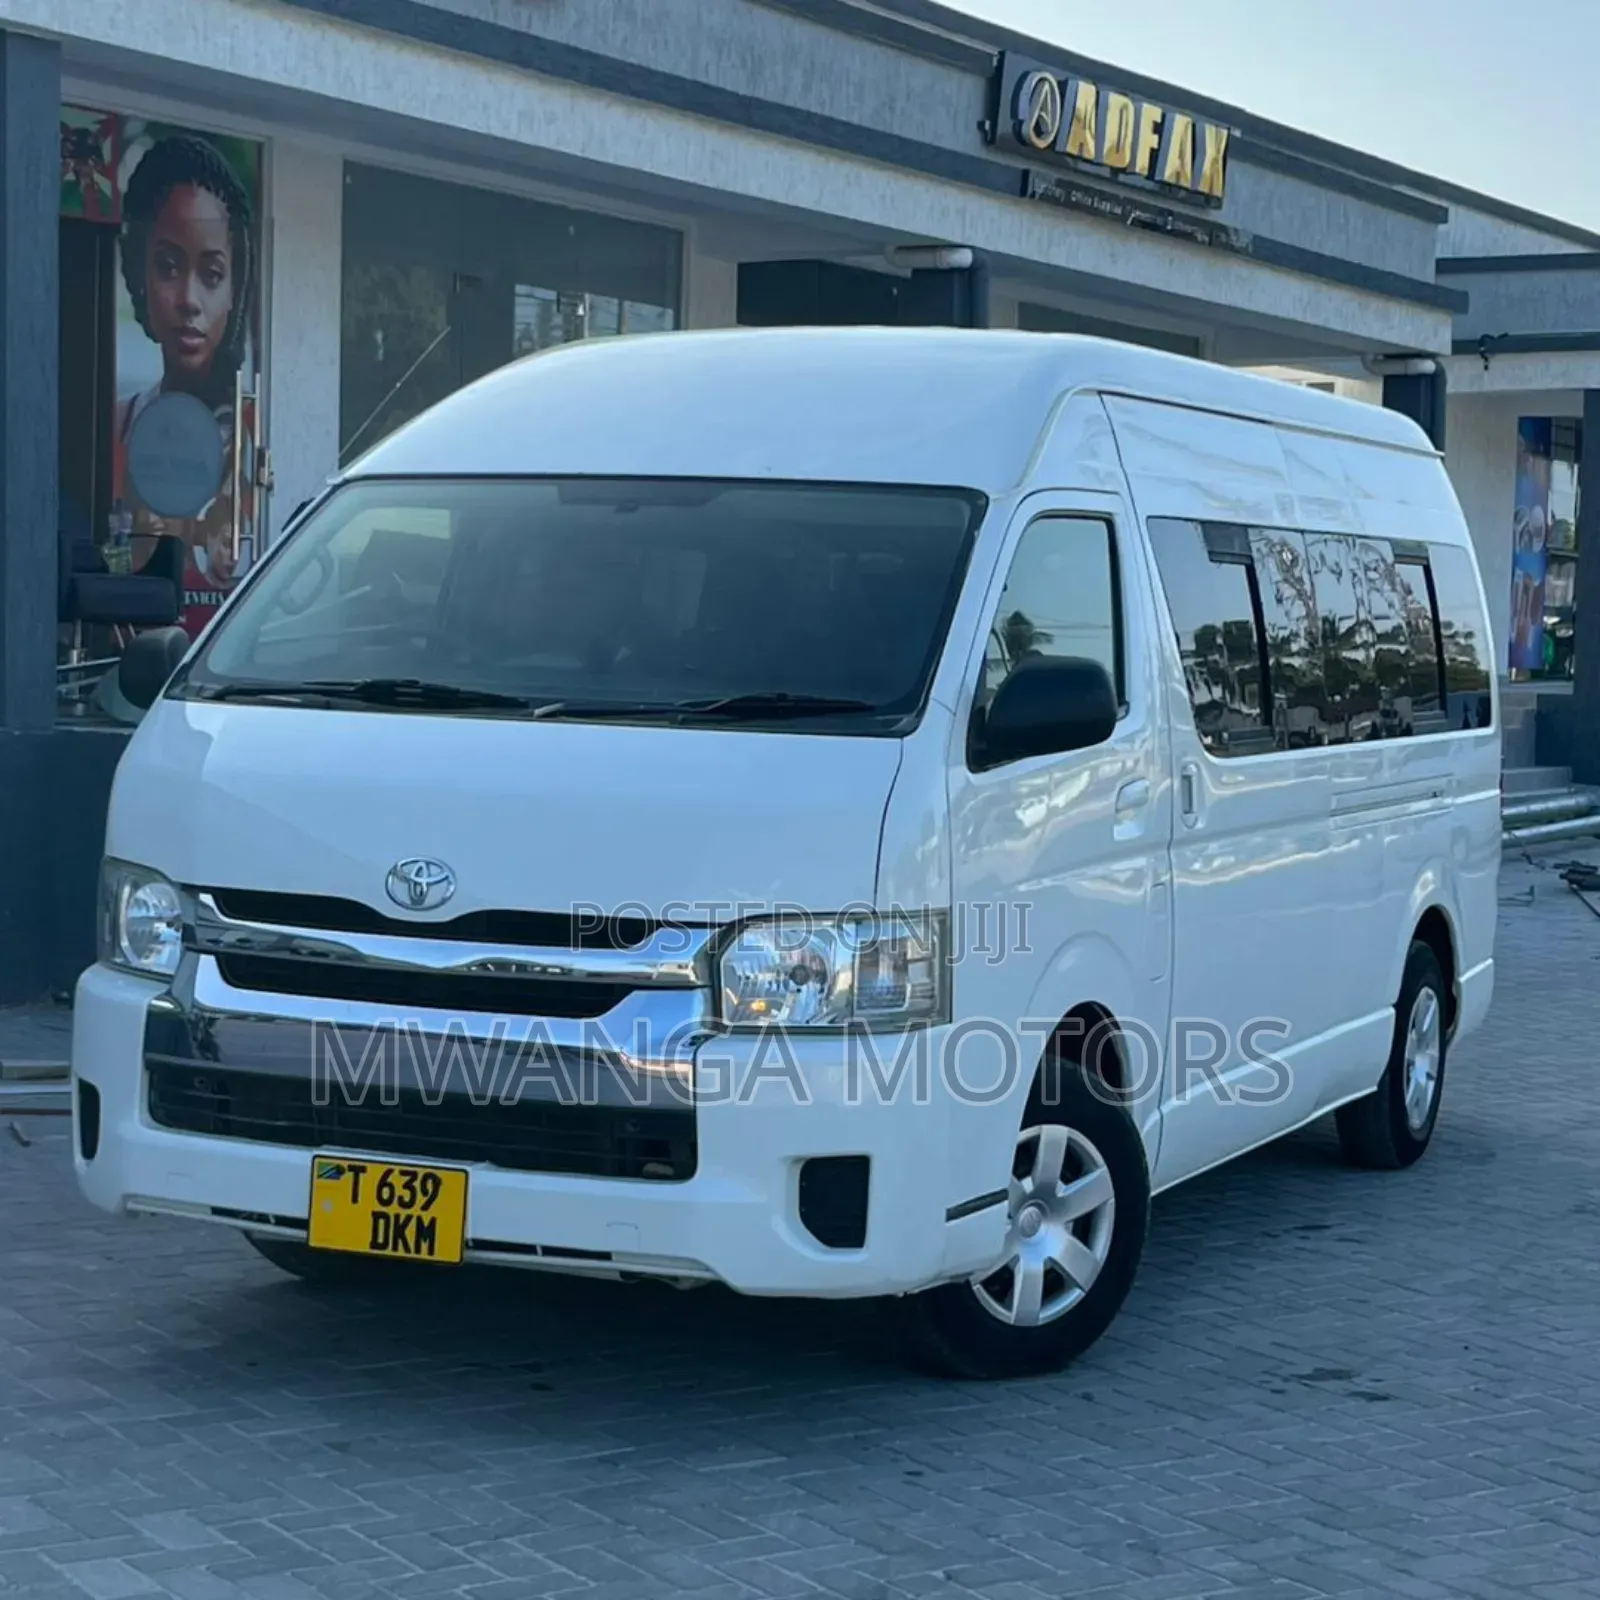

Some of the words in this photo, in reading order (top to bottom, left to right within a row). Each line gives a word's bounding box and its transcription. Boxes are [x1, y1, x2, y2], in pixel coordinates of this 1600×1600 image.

[1062, 79, 1229, 198] ADFAX
[347, 1164, 368, 1205] T
[375, 1167, 442, 1212] 639
[369, 1209, 438, 1257] DKM
